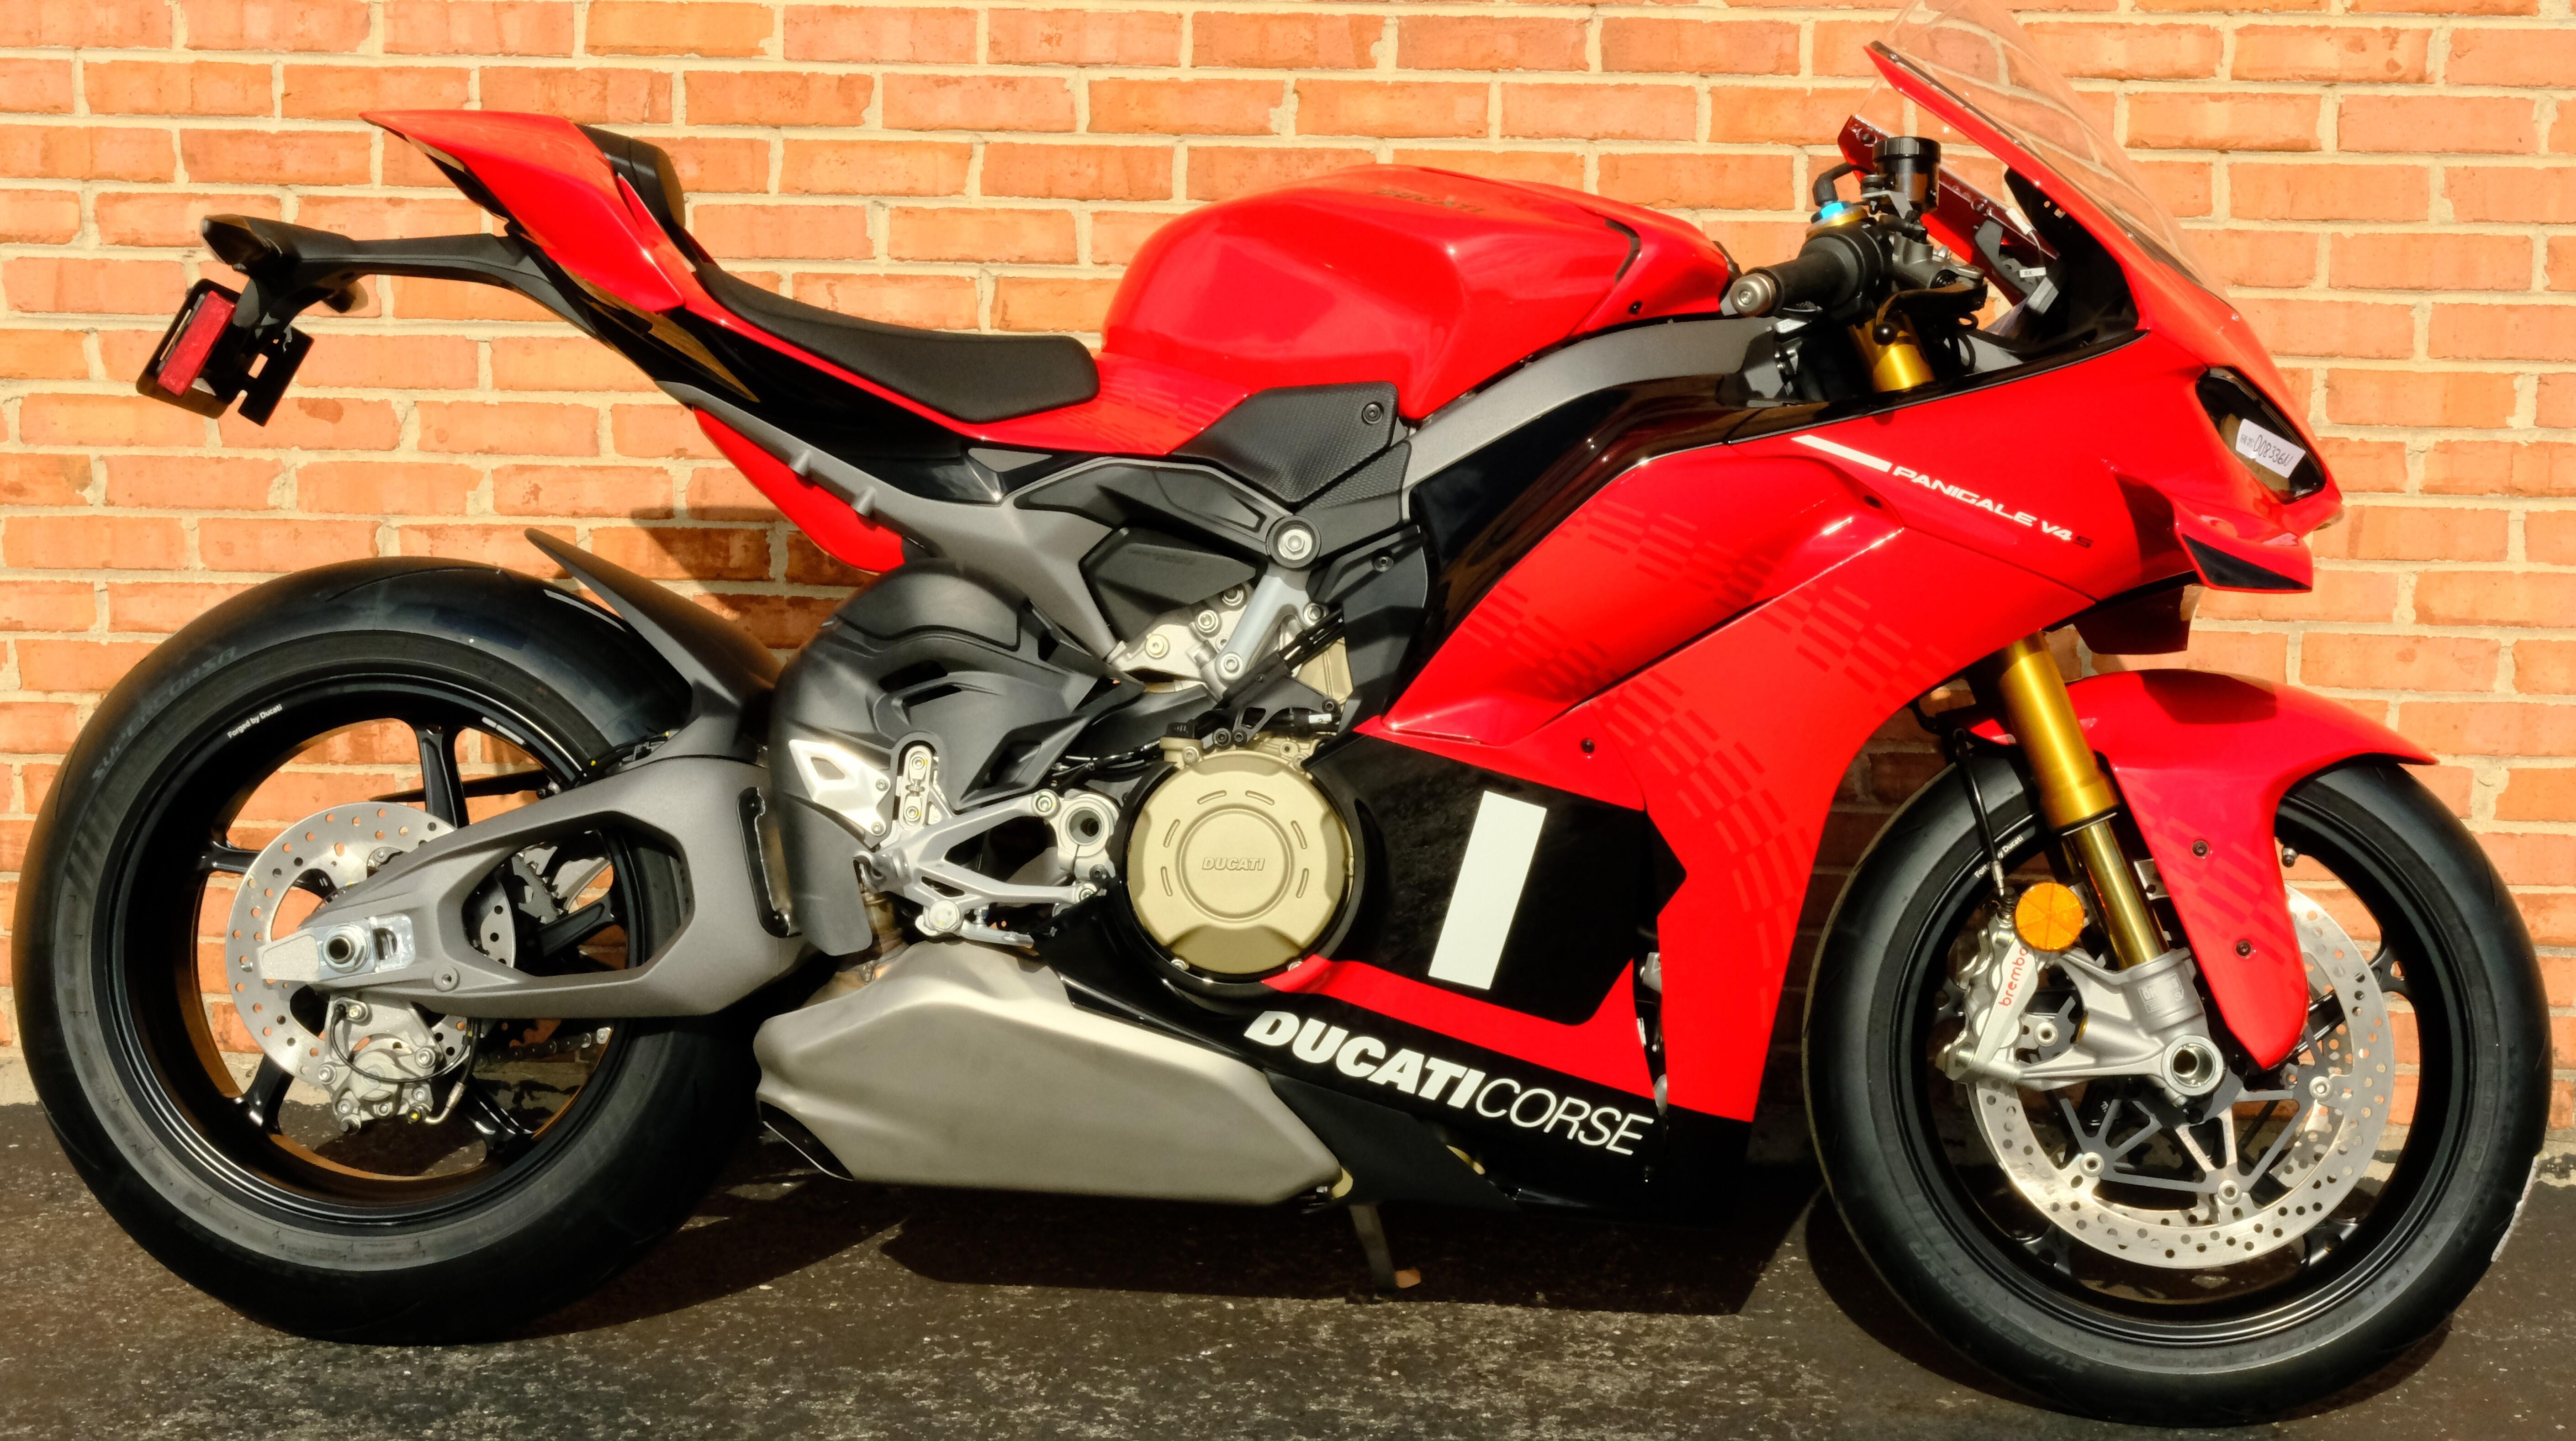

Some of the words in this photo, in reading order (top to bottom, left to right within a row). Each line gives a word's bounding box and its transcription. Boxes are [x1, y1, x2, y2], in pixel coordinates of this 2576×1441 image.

[1893, 466, 2037, 527] PANIGALE
[2041, 520, 2073, 541] V4
[2073, 535, 2095, 549] S
[227, 719, 251, 739] Forged
[249, 716, 259, 724] by
[259, 703, 283, 719] Ducati
[1202, 857, 1265, 871] DUCATI
[2002, 834, 2024, 853] Ducati
[1998, 947, 2029, 1007] brembo
[1243, 1010, 1486, 1109] DUCATI
[1475, 1077, 1654, 1156] CORSE
